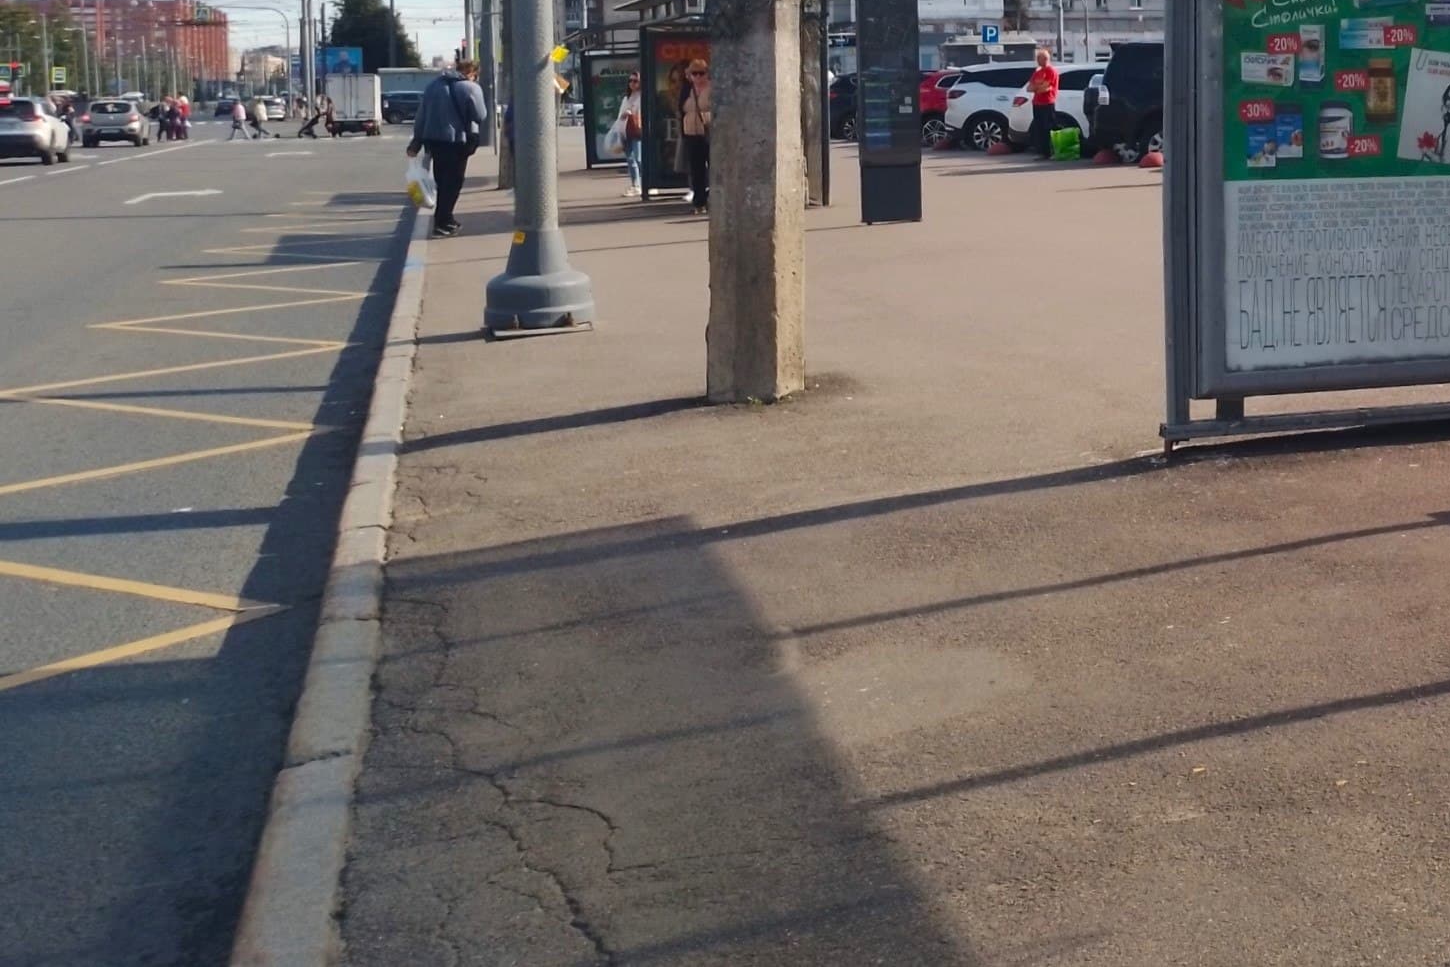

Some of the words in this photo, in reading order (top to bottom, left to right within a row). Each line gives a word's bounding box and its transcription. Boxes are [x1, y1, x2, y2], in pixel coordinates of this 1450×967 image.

[986, 27, 997, 42] P
[1386, 27, 1413, 42] -20%
[1270, 37, 1298, 51] -20%
[1337, 73, 1365, 88] -20%
[1242, 103, 1270, 118] -30%
[1350, 138, 1378, 153] -20%
[1282, 277, 1302, 347] НЕ
[1306, 274, 1387, 346] ЯВЛЯЕТСЯ
